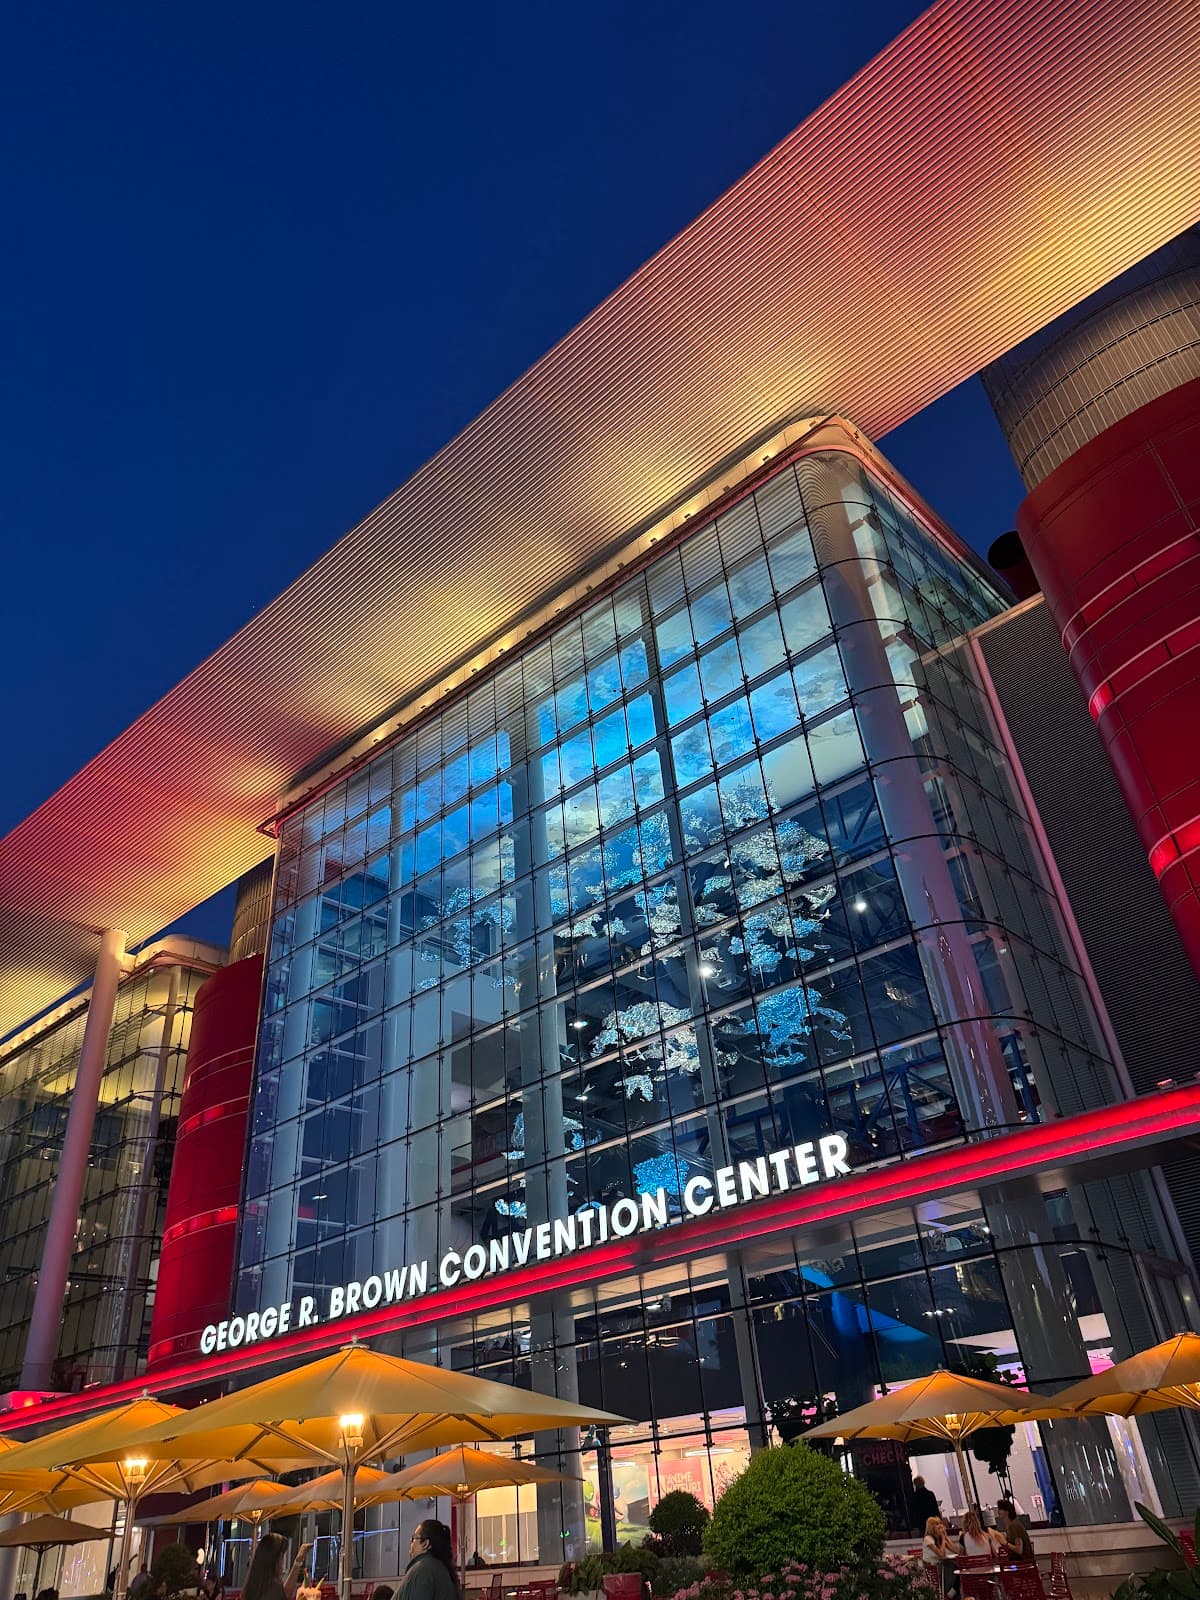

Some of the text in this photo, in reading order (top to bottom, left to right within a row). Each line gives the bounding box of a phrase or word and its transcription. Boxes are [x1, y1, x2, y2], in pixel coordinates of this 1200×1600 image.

[199, 1133, 851, 1355] GEORGE R. BROWN CONVENTION CENTER
